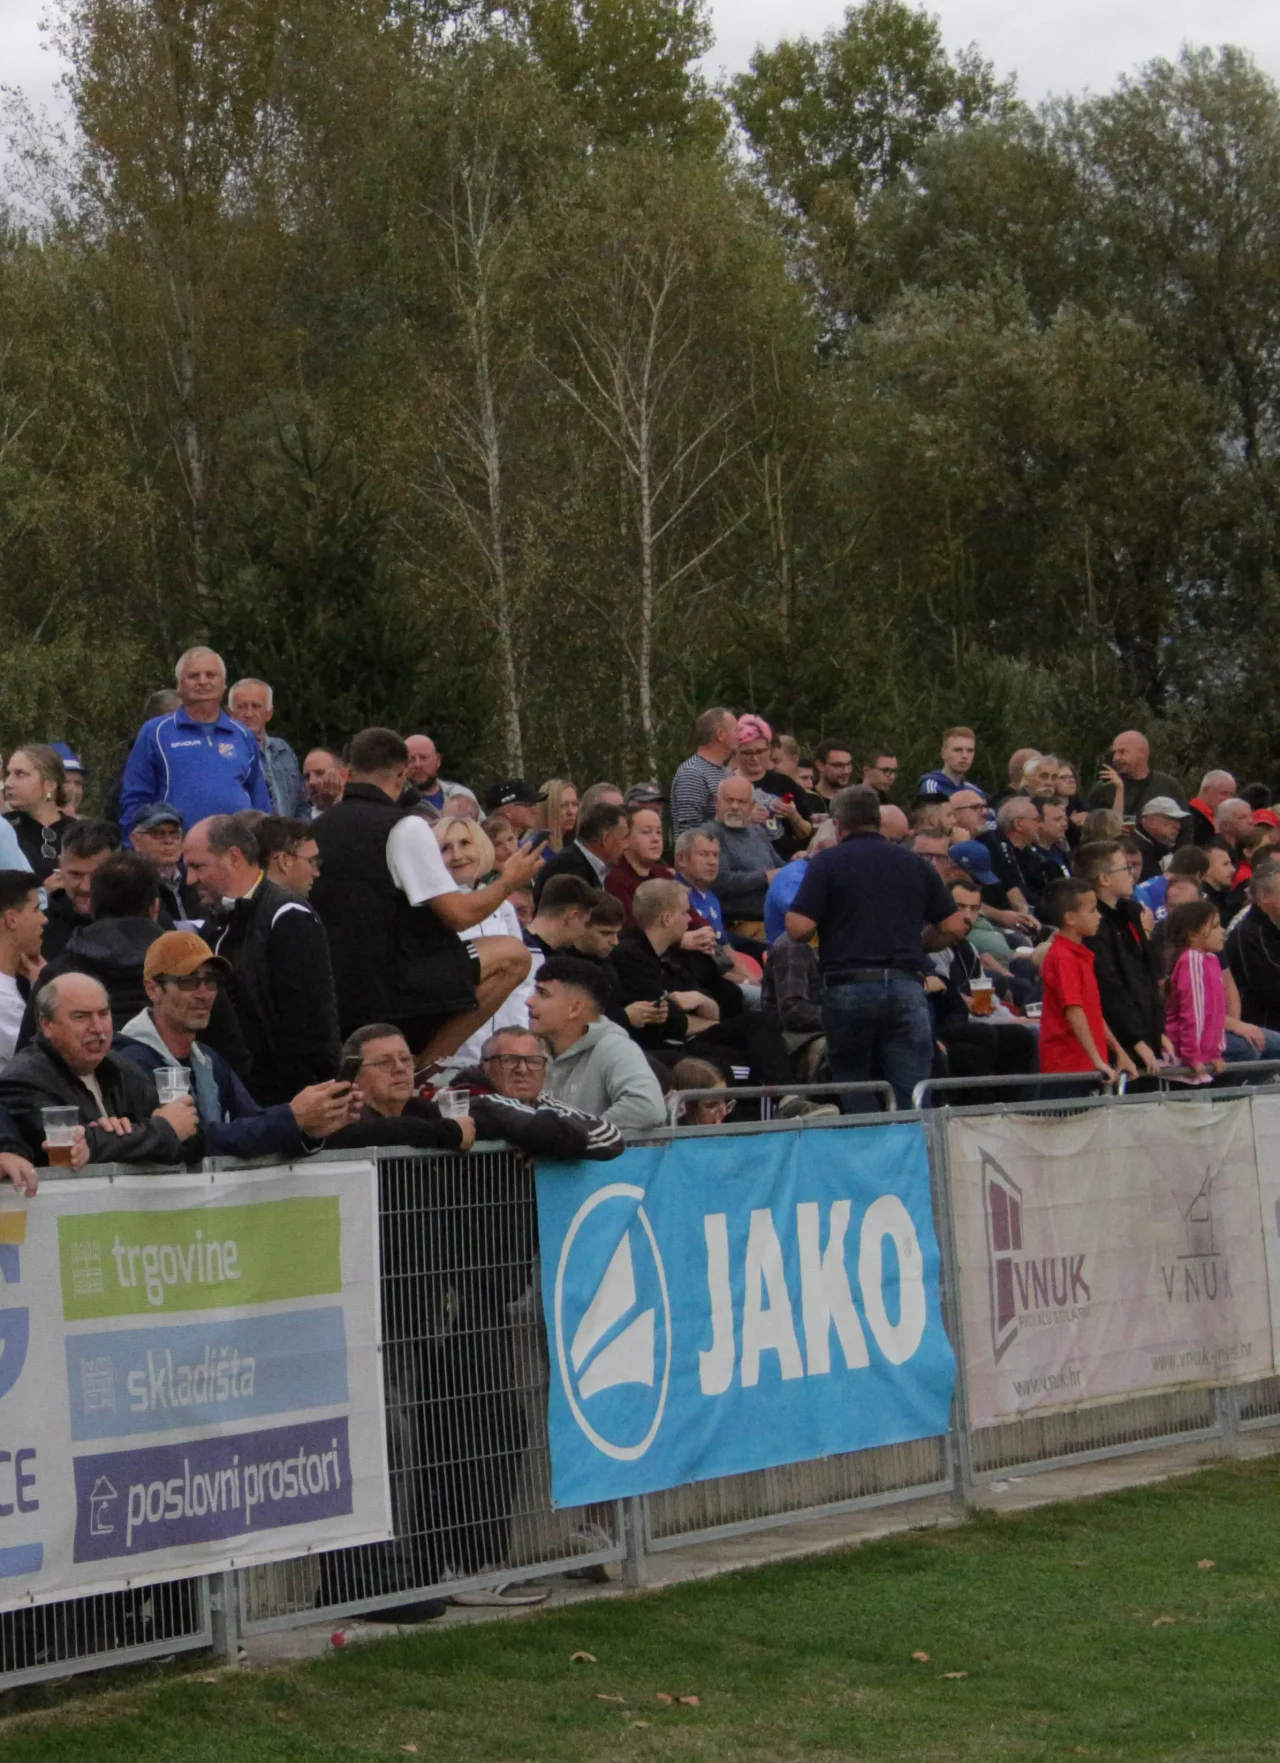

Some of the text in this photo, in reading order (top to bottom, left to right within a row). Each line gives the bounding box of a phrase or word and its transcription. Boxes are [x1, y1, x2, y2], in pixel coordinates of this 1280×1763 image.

[111, 1230, 240, 1305] trgovine
[699, 1195, 926, 1395] JAKO
[1013, 1254, 1090, 1310] VNUK
[1162, 1261, 1232, 1304] VNUK
[128, 1346, 256, 1412] skladišta
[127, 1438, 341, 1547] poslovni prostori
